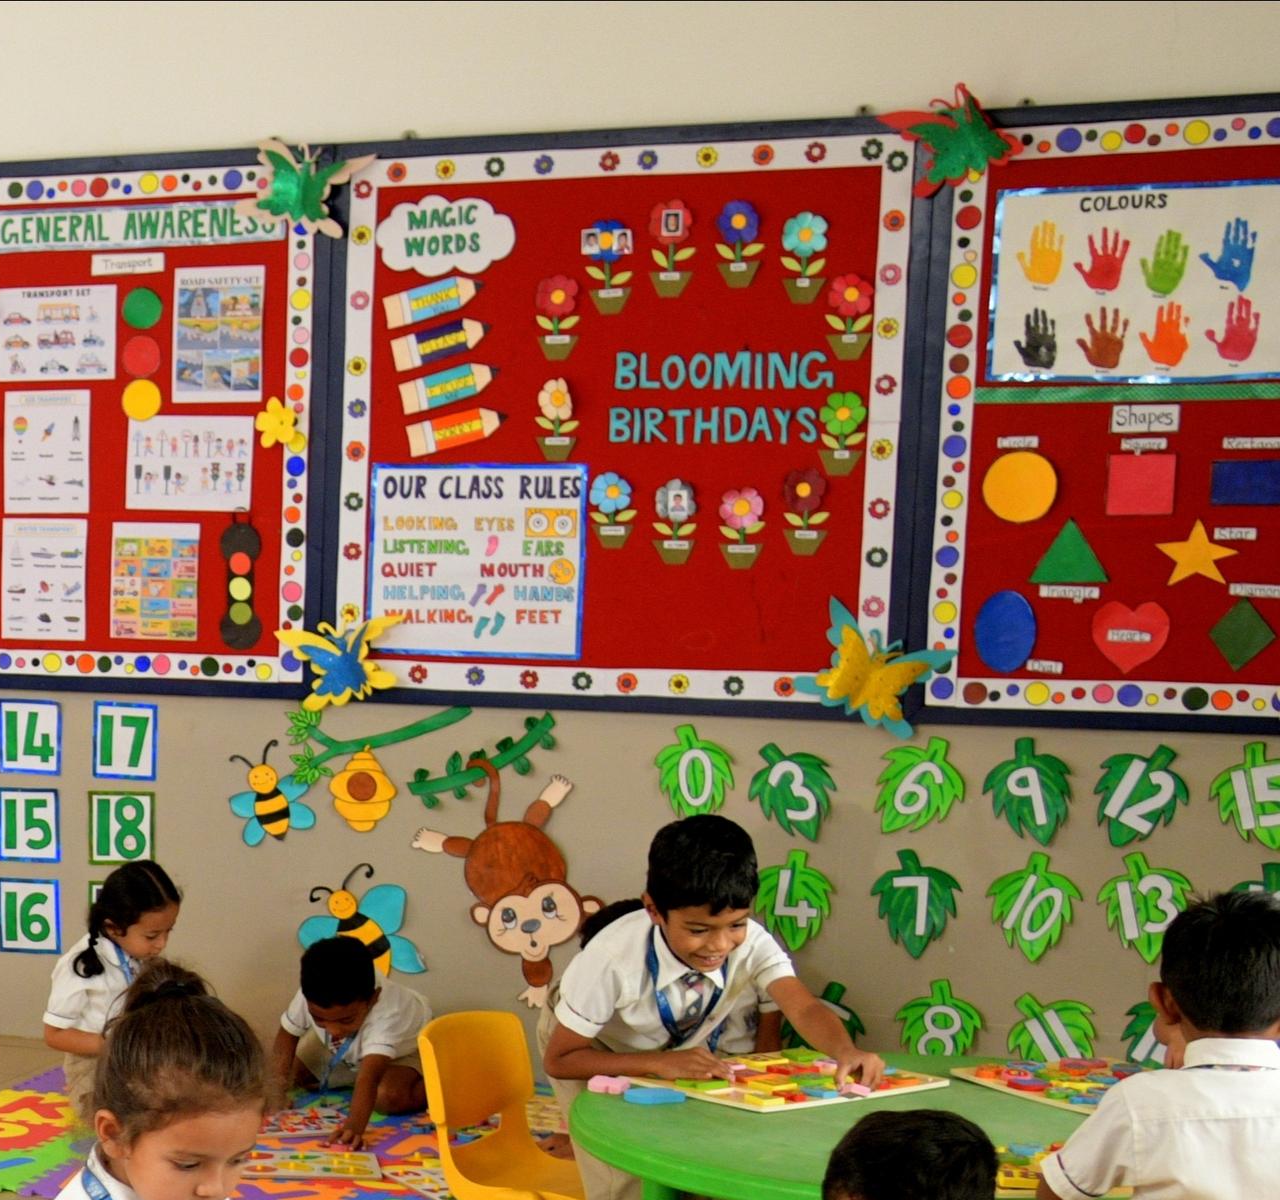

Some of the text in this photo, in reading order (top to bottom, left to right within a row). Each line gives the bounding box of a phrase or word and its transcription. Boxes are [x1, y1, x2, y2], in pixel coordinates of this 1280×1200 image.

[1080, 193, 1168, 213] COLOURS
[407, 204, 478, 230] MAGIC
[0, 213, 110, 245] GENERAL
[404, 232, 481, 257] WORDS
[102, 257, 153, 273] Transport
[207, 277, 242, 285] SAFETY
[243, 277, 260, 285] SET
[22, 287, 91, 299] TRANSPORT SET
[614, 352, 834, 390] BLOOMING
[609, 407, 817, 445] BIRTHDAYS
[1116, 408, 1174, 431] Shapes
[999, 438, 1034, 448] Circle
[1123, 440, 1163, 455] Square
[384, 475, 581, 499] OUR CLASS RULES
[383, 515, 515, 531] LOOKING EYES
[1218, 529, 1250, 541] Star
[383, 539, 565, 556] LISTENING EARS
[381, 562, 544, 578] QUIET MOUTH
[383, 584, 575, 602] HELPING HANDS
[1047, 586, 1094, 602] Triangle
[384, 609, 562, 624] WALKING FEET
[1031, 662, 1060, 673] Oval
[5, 710, 54, 763] 14
[100, 715, 150, 768] 17
[678, 749, 713, 806] 0
[768, 760, 818, 821] 3
[894, 761, 944, 815] 6
[1006, 766, 1048, 826] 9
[1104, 758, 1176, 835] 12
[5, 799, 52, 850] 15
[96, 796, 146, 860] 18
[774, 869, 1179, 941] 4 7 10 13
[5, 891, 51, 942] 16
[917, 1005, 1082, 1062] 8 11
